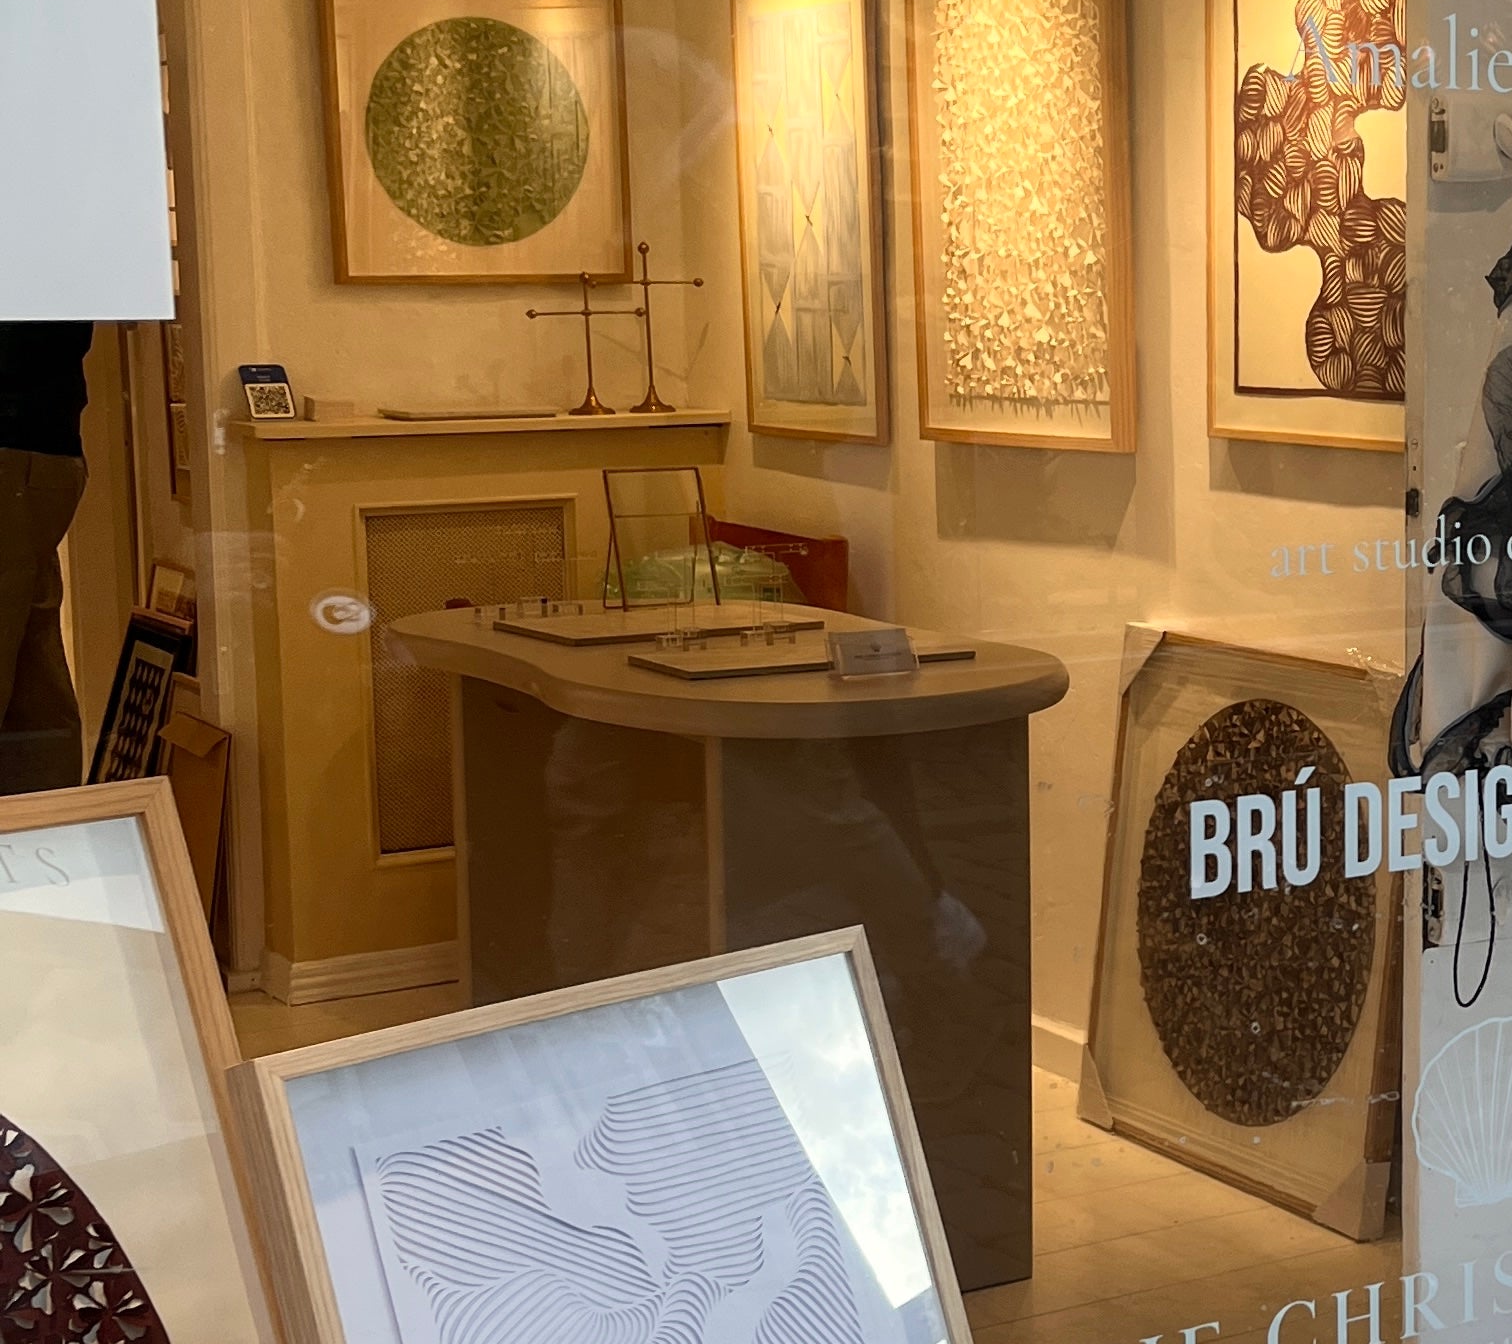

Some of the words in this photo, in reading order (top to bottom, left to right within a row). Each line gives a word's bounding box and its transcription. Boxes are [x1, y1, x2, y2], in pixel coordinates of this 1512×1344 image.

[1268, 538, 1335, 578] art
[1352, 513, 1492, 573] studio
[1189, 765, 1322, 901] BRÚ
